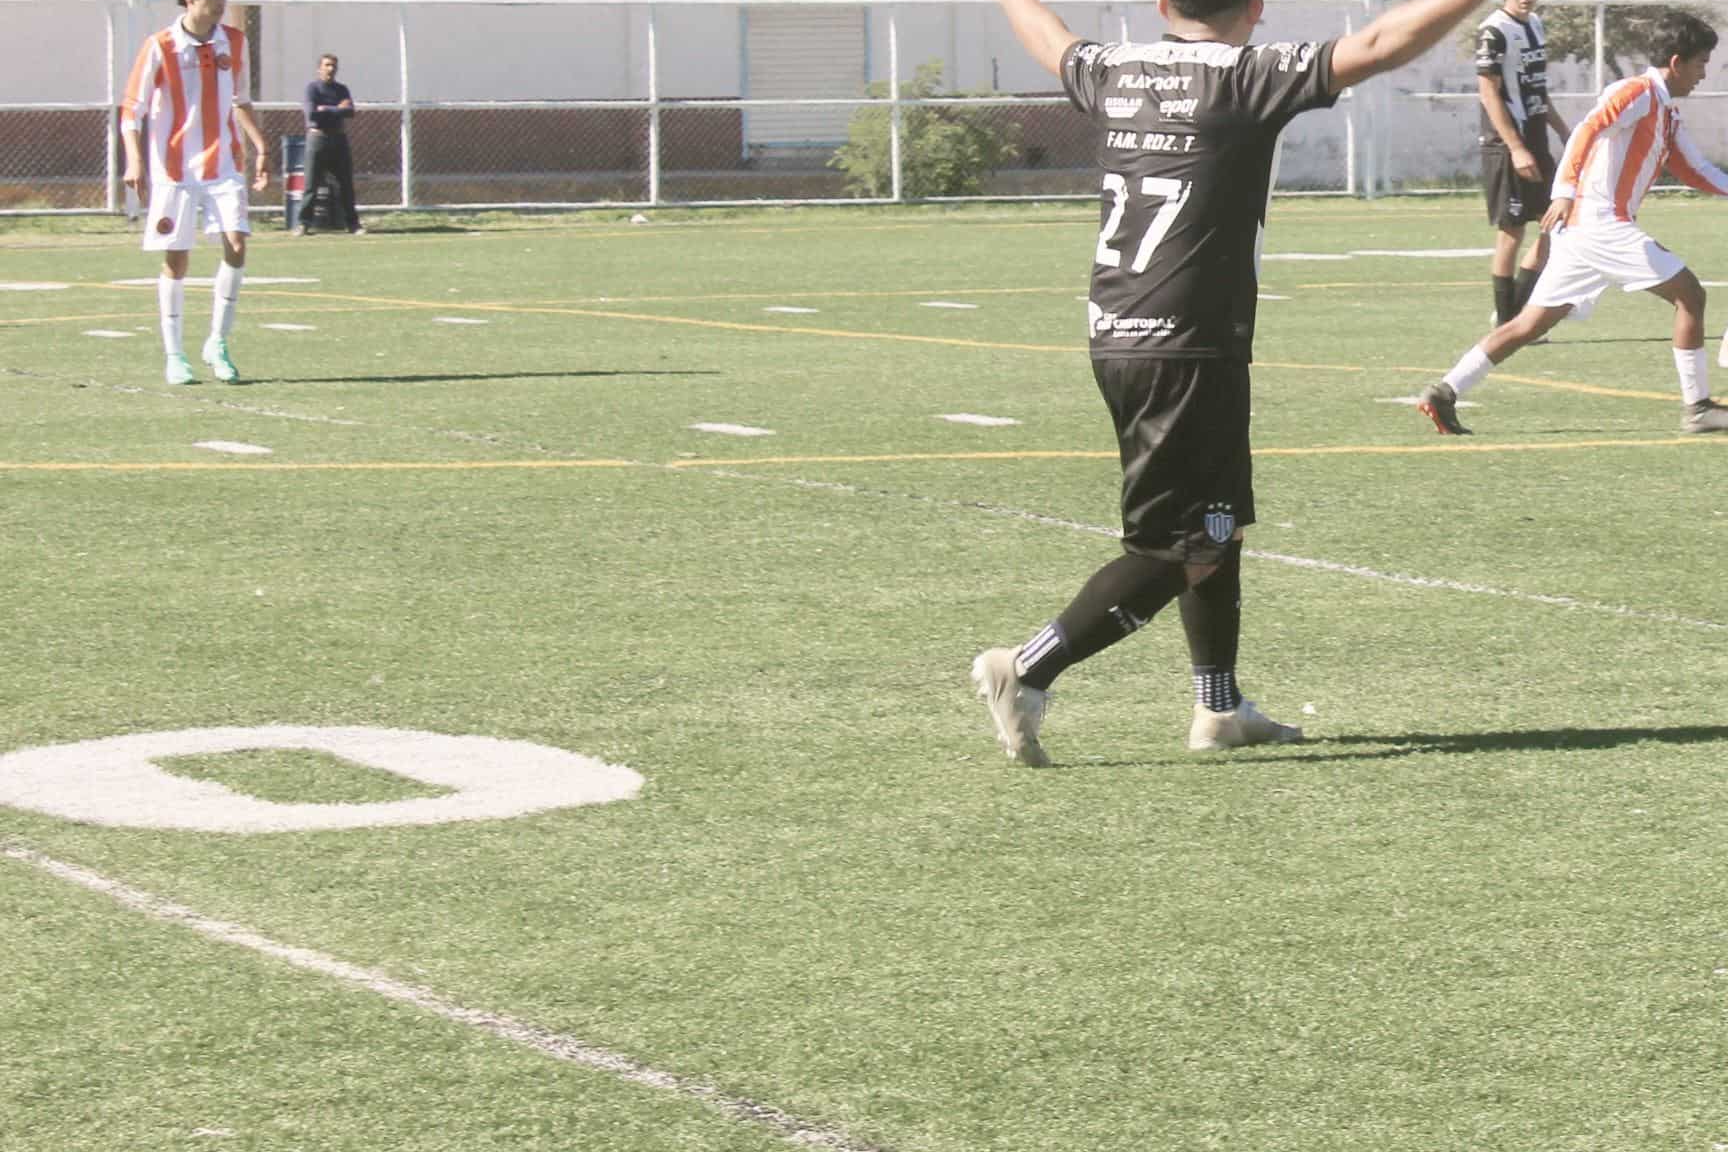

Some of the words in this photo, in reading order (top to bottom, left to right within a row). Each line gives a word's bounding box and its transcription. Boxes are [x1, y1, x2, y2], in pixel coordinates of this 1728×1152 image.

[1106, 131, 1138, 149] FAM.
[1142, 133, 1178, 151] RDZ.
[1183, 135, 1196, 152] T
[1095, 173, 1193, 273] 27
